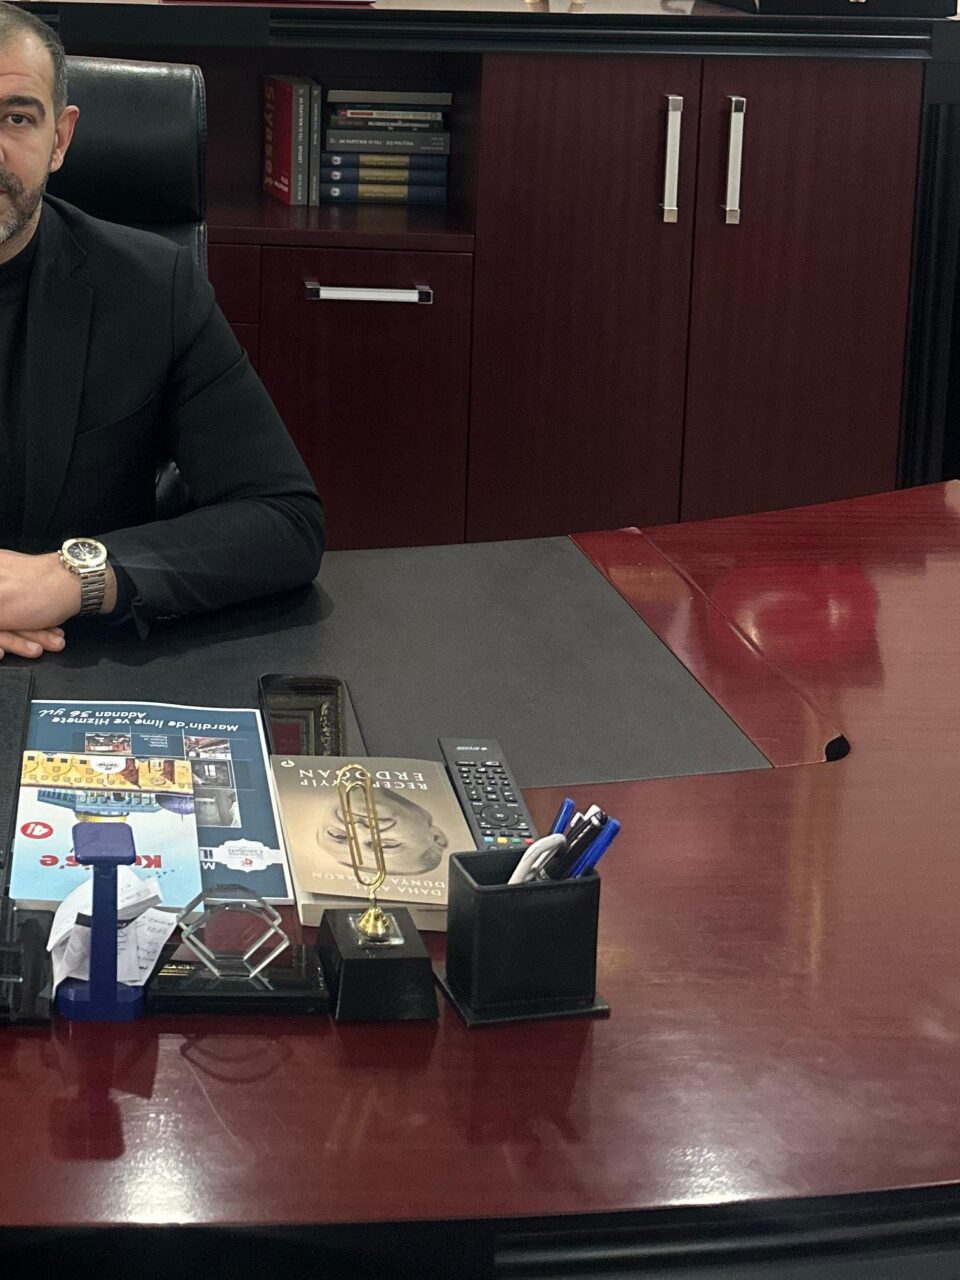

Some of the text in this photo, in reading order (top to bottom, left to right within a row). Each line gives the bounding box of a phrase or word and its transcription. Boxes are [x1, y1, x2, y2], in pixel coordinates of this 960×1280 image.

[38, 708, 65, 719] yıl
[95, 711, 147, 719] Adanan
[51, 717, 110, 726] Hizmete
[135, 718, 164, 729] İlme
[167, 720, 239, 732] Mardin'de
[300, 779, 428, 790] RECEP AYYİP
[396, 886, 442, 896] DAHA
